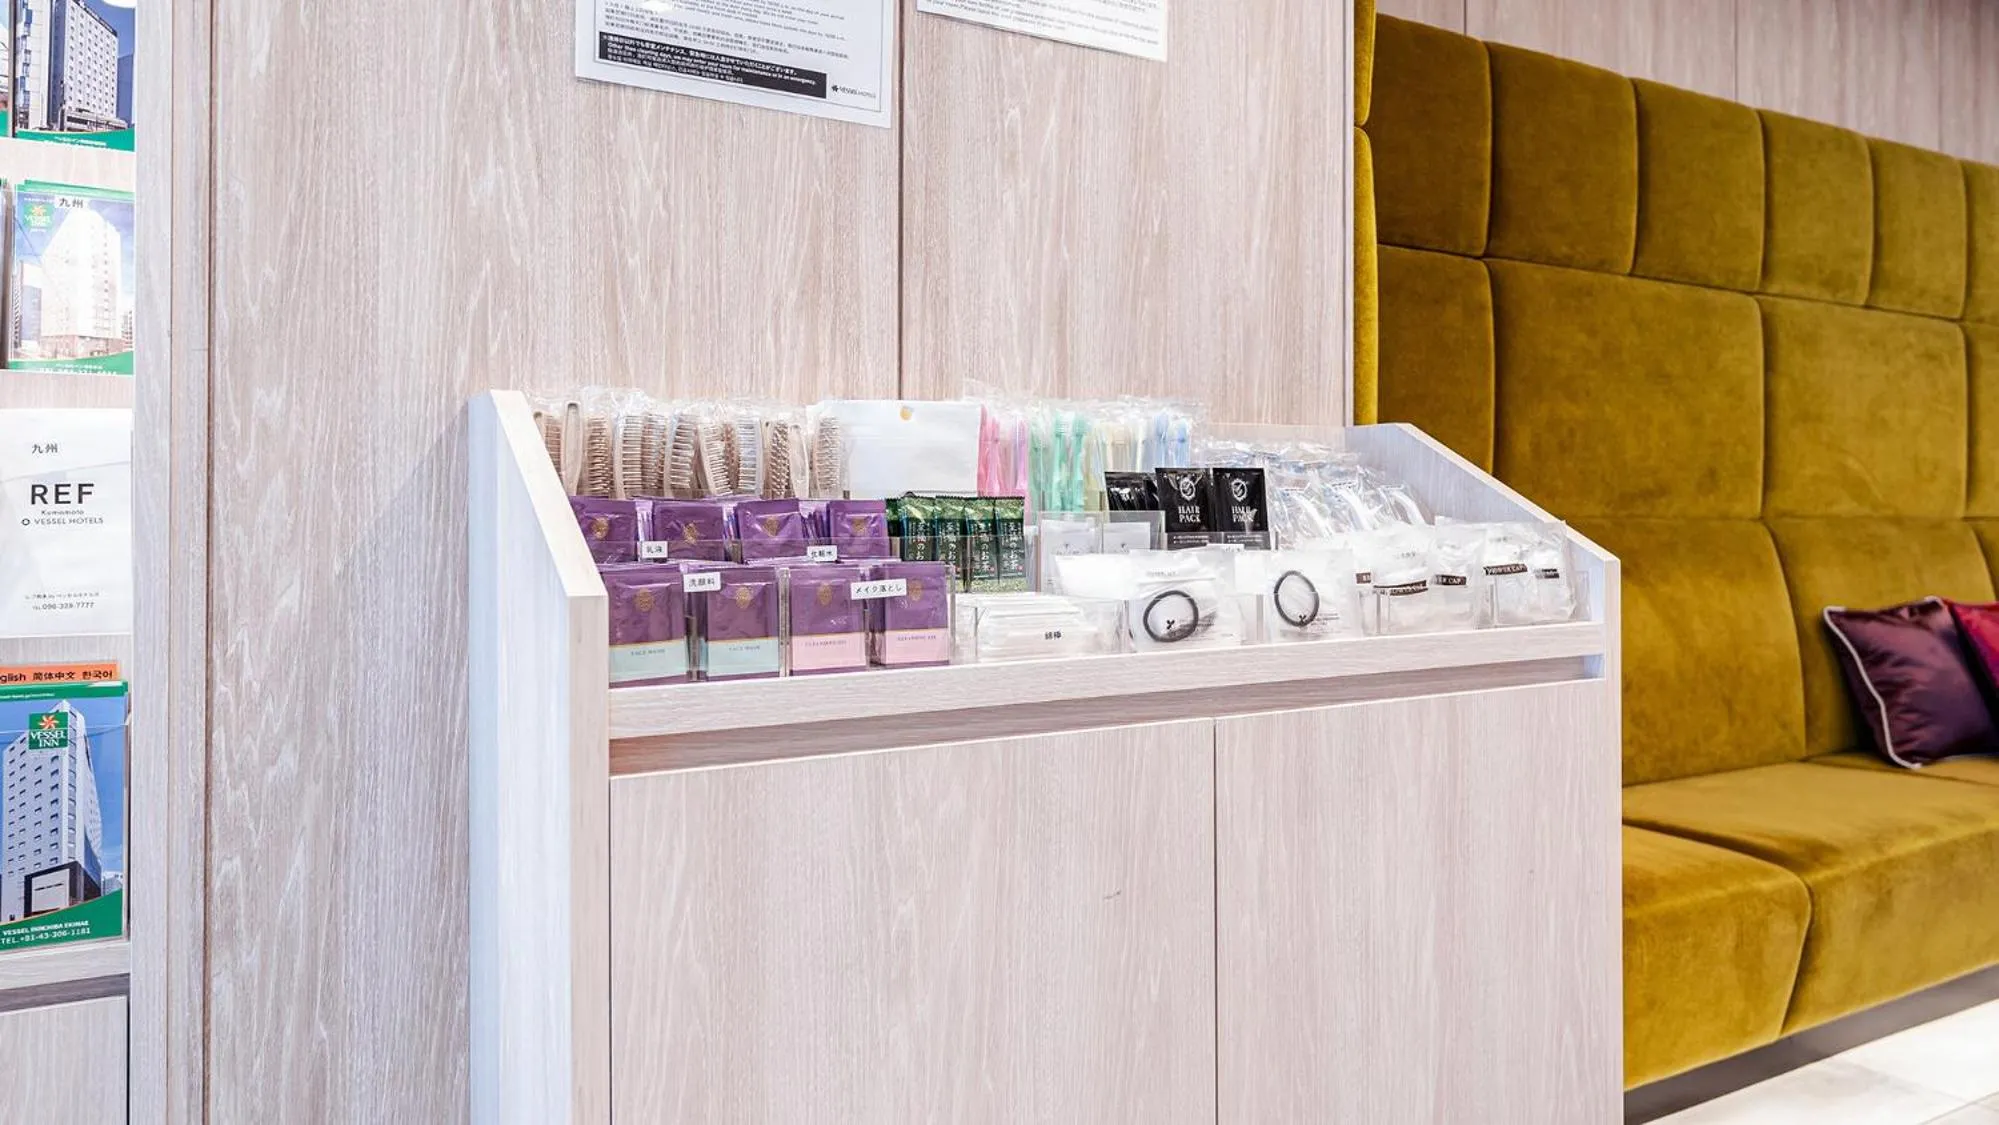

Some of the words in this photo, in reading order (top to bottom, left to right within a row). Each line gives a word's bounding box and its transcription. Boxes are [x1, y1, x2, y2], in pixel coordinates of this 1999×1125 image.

[59, 198, 84, 208] 九州
[32, 443, 58, 454] 九州
[31, 483, 95, 505] REF
[1178, 506, 1200, 514] HAIR
[1179, 514, 1201, 523] PACK
[688, 578, 715, 588] 洗顔料
[855, 585, 903, 594] メイク落とし
[82, 670, 113, 680] 한국어
[31, 731, 67, 740] VESSEL
[39, 739, 59, 748] INN
